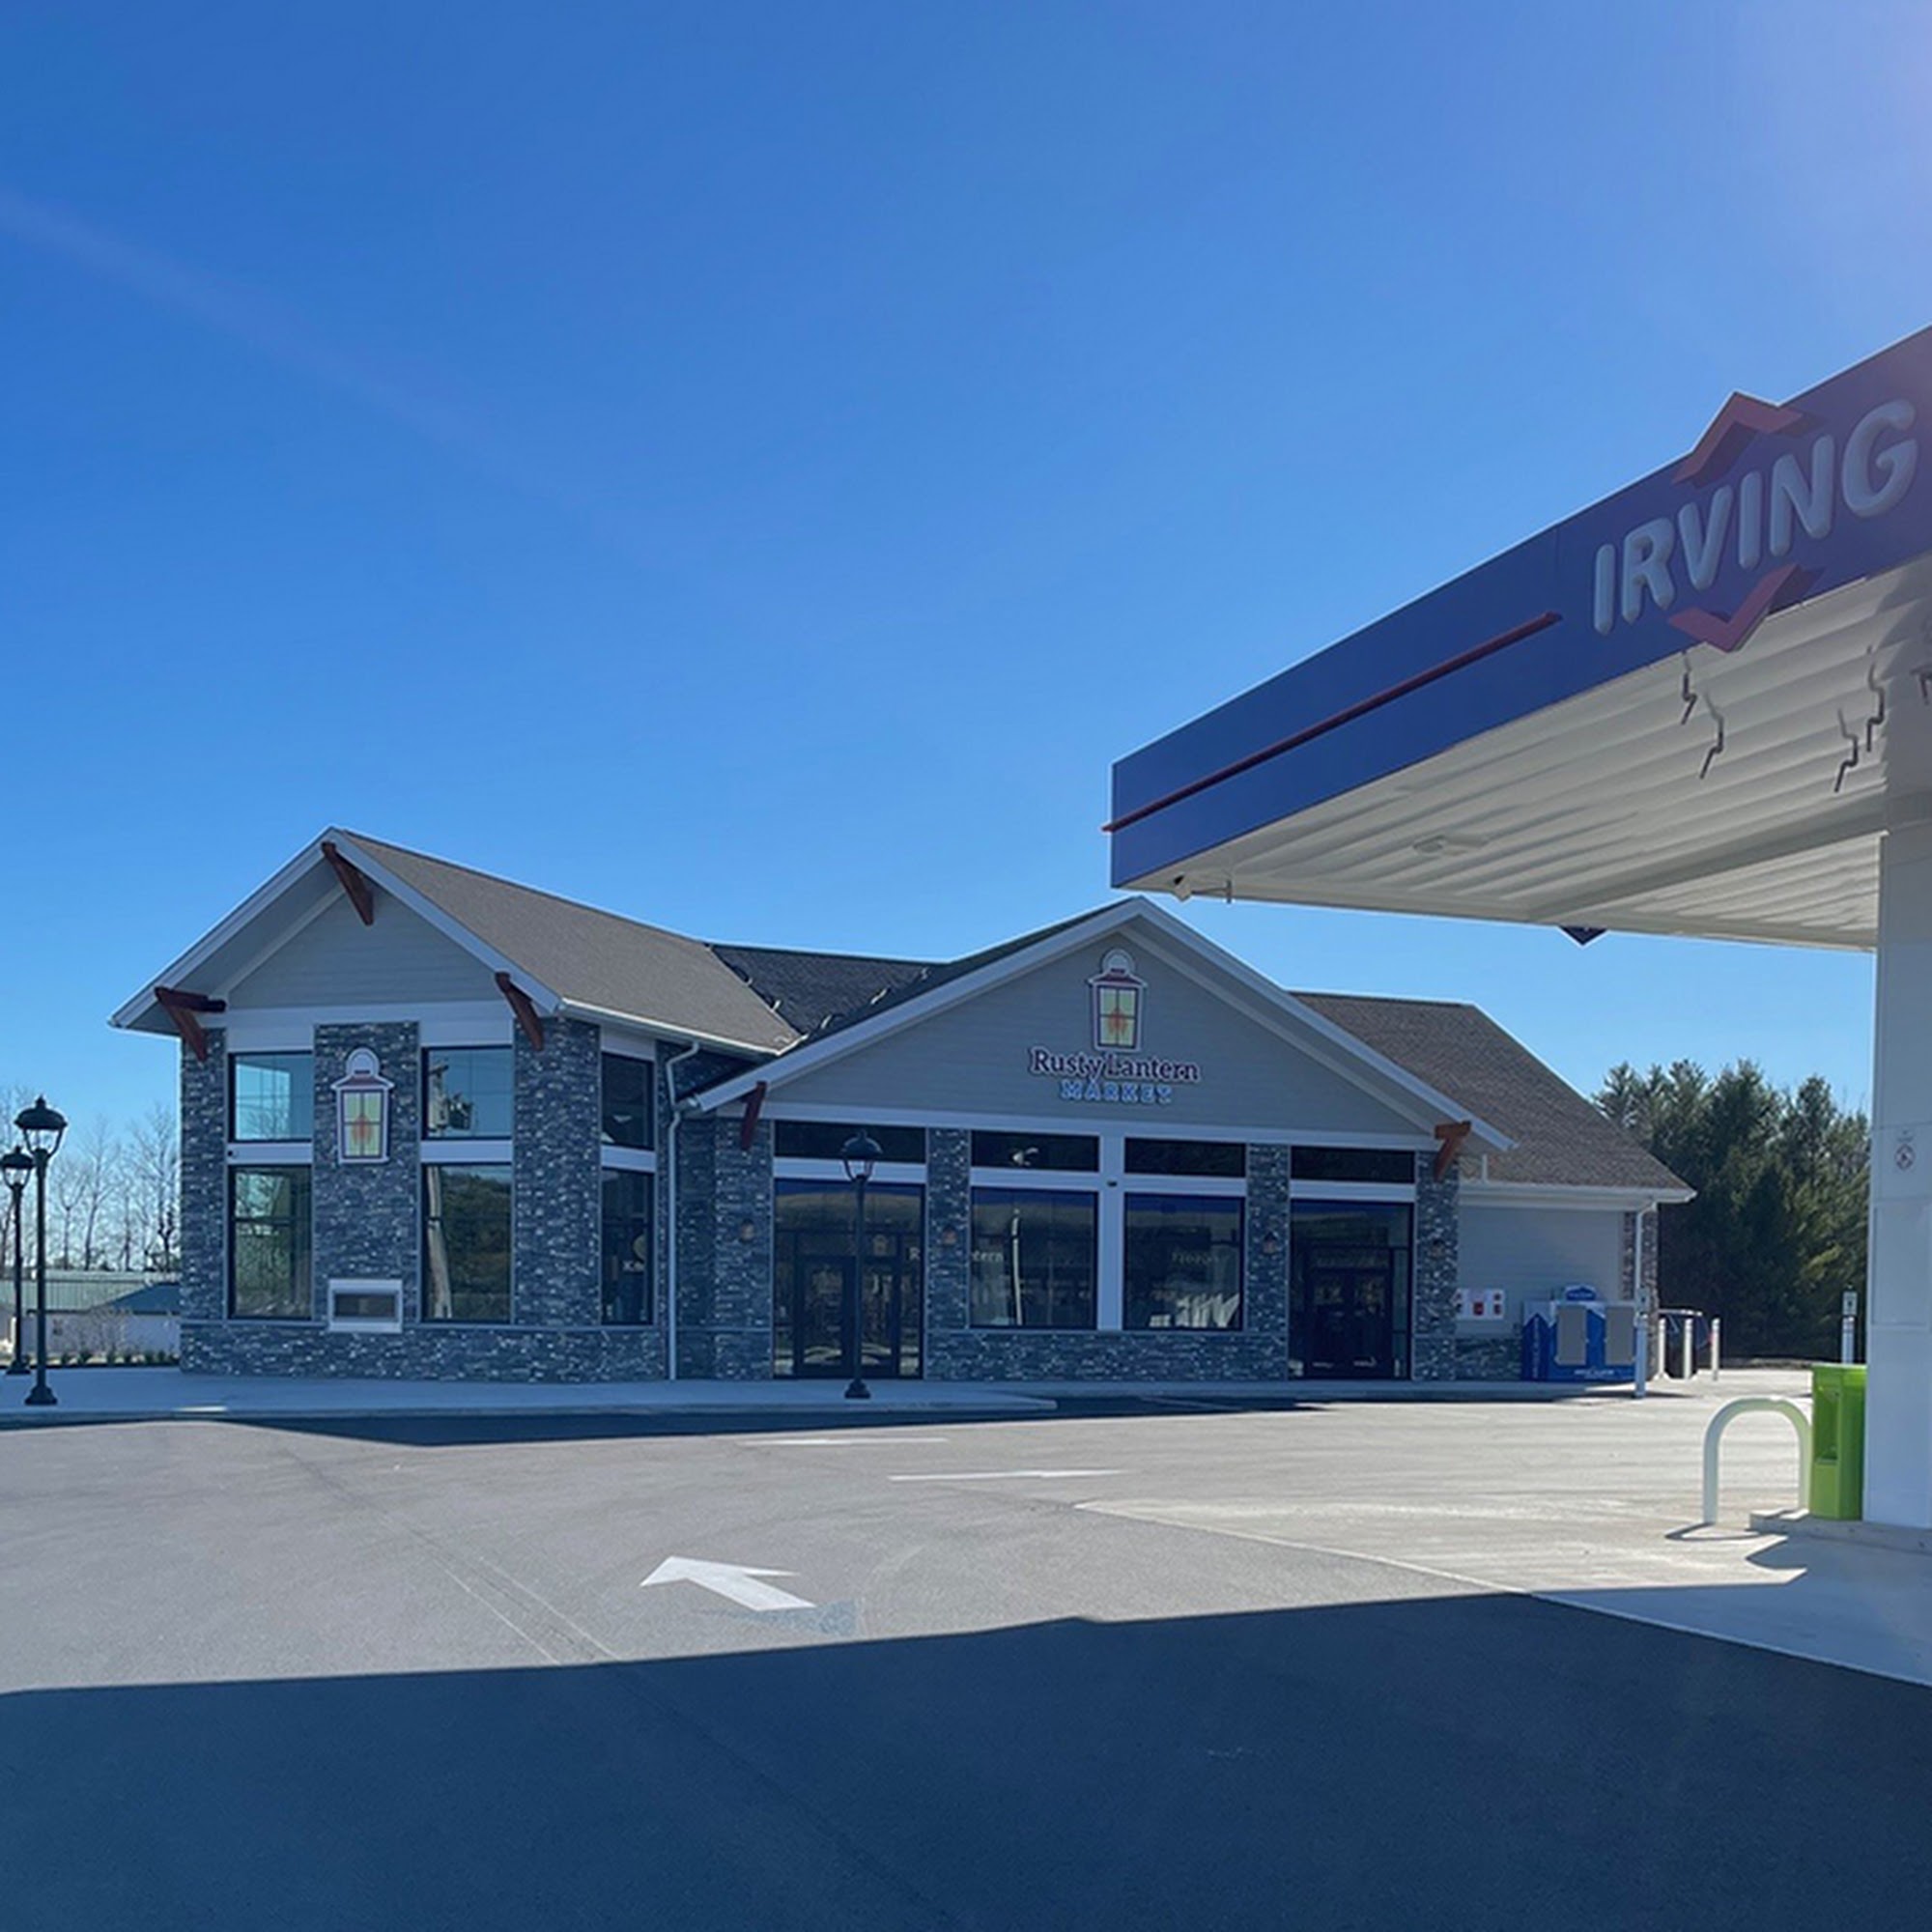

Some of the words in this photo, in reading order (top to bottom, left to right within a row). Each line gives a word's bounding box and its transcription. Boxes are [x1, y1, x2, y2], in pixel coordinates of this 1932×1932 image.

[1594, 399, 1918, 636] IRVING
[1031, 1046, 1104, 1079] Rusty
[1104, 1052, 1201, 1082] Lantern
[1060, 1079, 1172, 1103] MARKET
